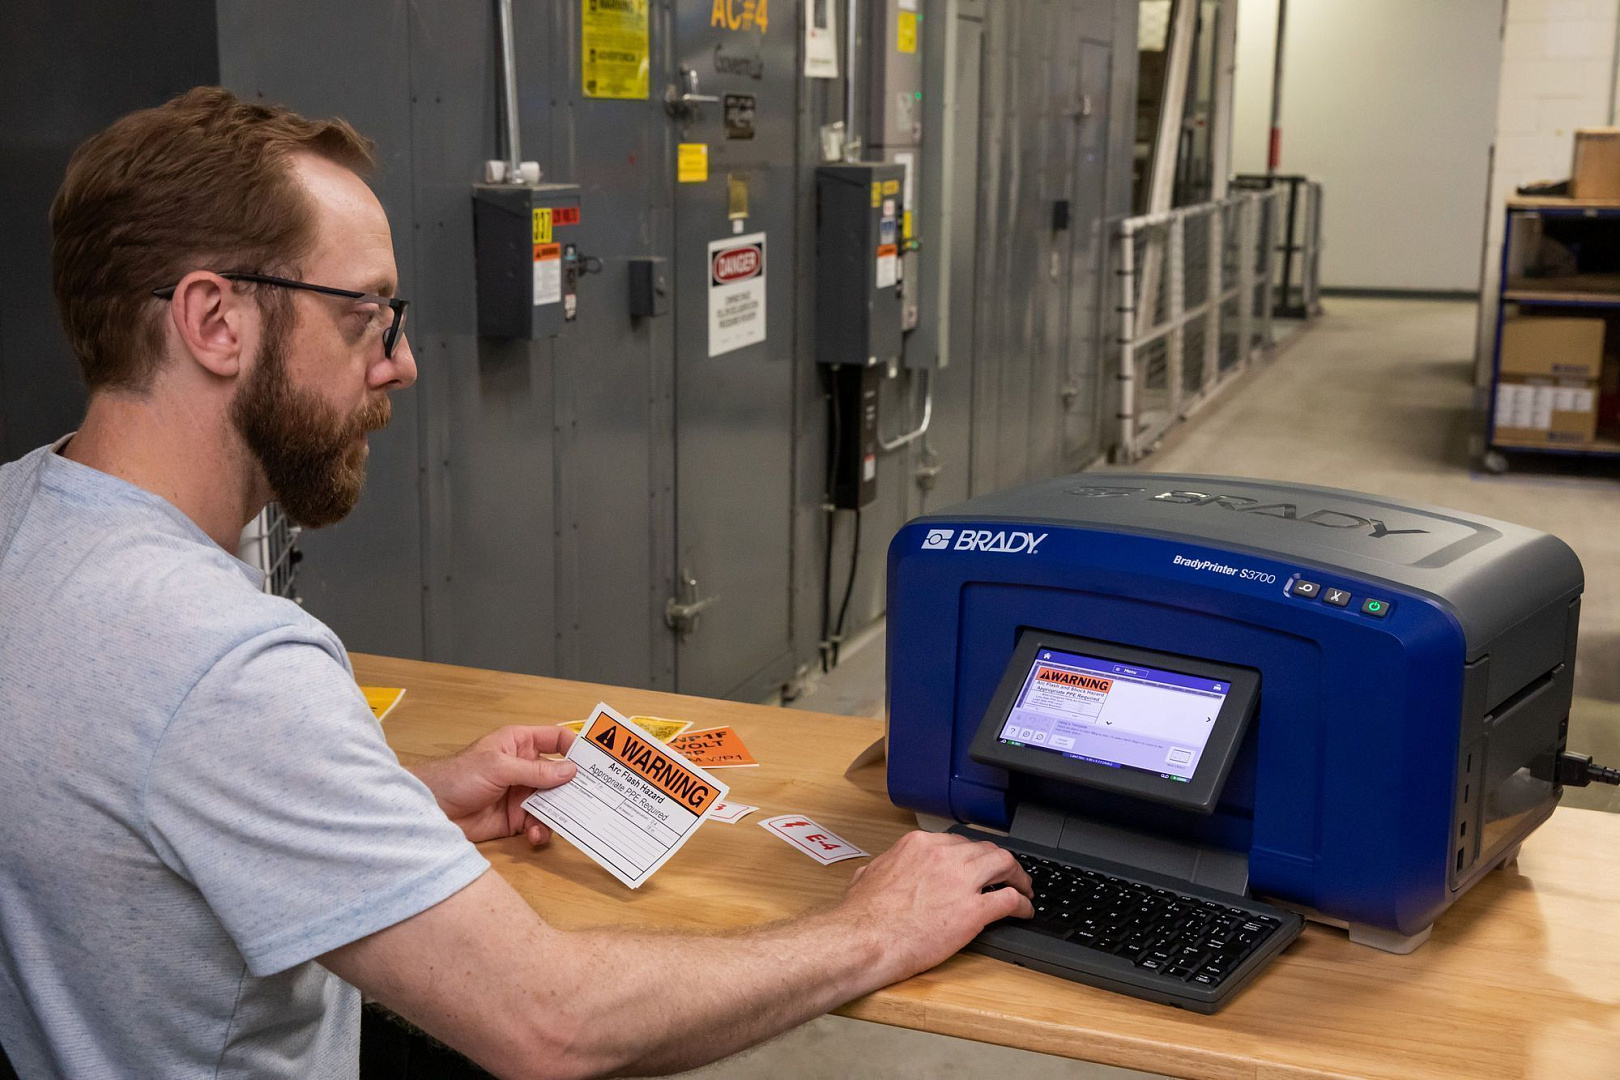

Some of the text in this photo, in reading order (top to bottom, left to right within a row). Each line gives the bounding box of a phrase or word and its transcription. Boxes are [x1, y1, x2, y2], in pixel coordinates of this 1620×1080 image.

[710, 0, 768, 33] AC#4
[718, 251, 757, 278] DANGER
[1147, 490, 1430, 538] BRADY
[953, 530, 1048, 554] BRADY
[1173, 555, 1276, 584] BradyPrinter S3700
[1051, 671, 1108, 691] WARNING
[608, 762, 622, 775] Arc
[622, 771, 641, 788] Flash
[640, 784, 666, 804] Hazard
[620, 736, 709, 808] WARNING
[589, 763, 625, 792] Appropriate
[624, 787, 640, 802] PPE
[639, 797, 670, 821] Required
[805, 833, 842, 851] E-4
